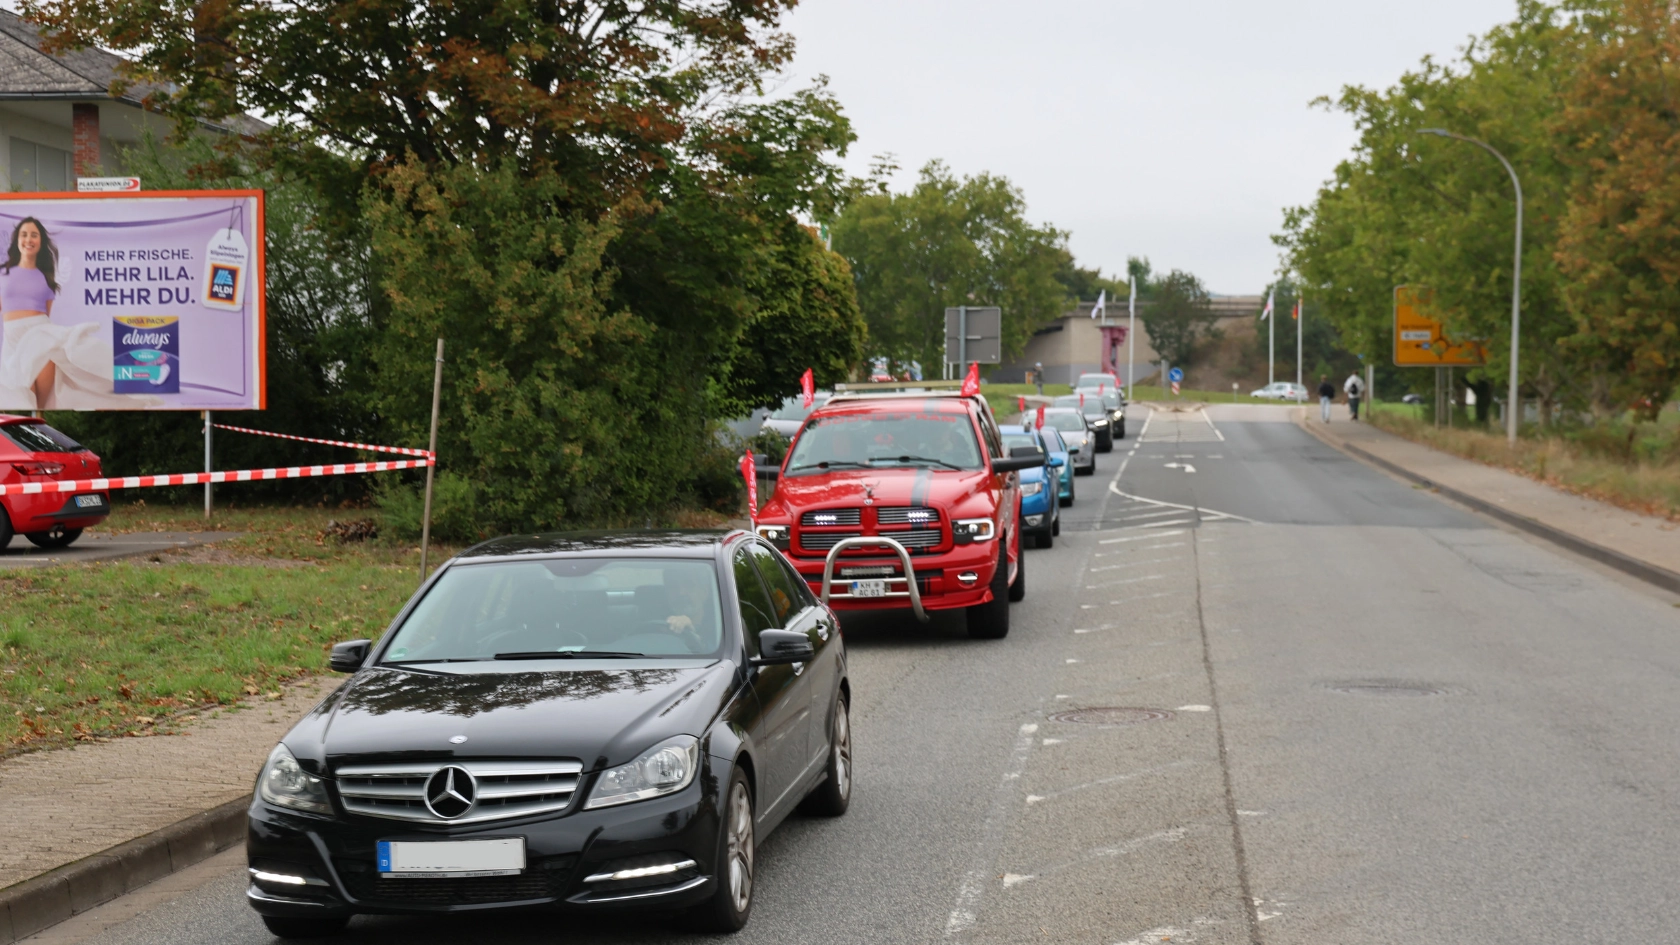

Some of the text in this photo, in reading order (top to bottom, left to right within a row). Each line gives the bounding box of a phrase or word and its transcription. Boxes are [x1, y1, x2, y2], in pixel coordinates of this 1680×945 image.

[84, 248, 194, 261] MEHR FRISCHE.
[84, 266, 194, 282] MEHR LILA.
[212, 284, 233, 295] ALDI
[84, 287, 195, 305] MEHR DU.
[146, 317, 165, 325] PACK
[122, 328, 171, 350] always
[860, 582, 871, 590] KH
[859, 589, 869, 597] AC
